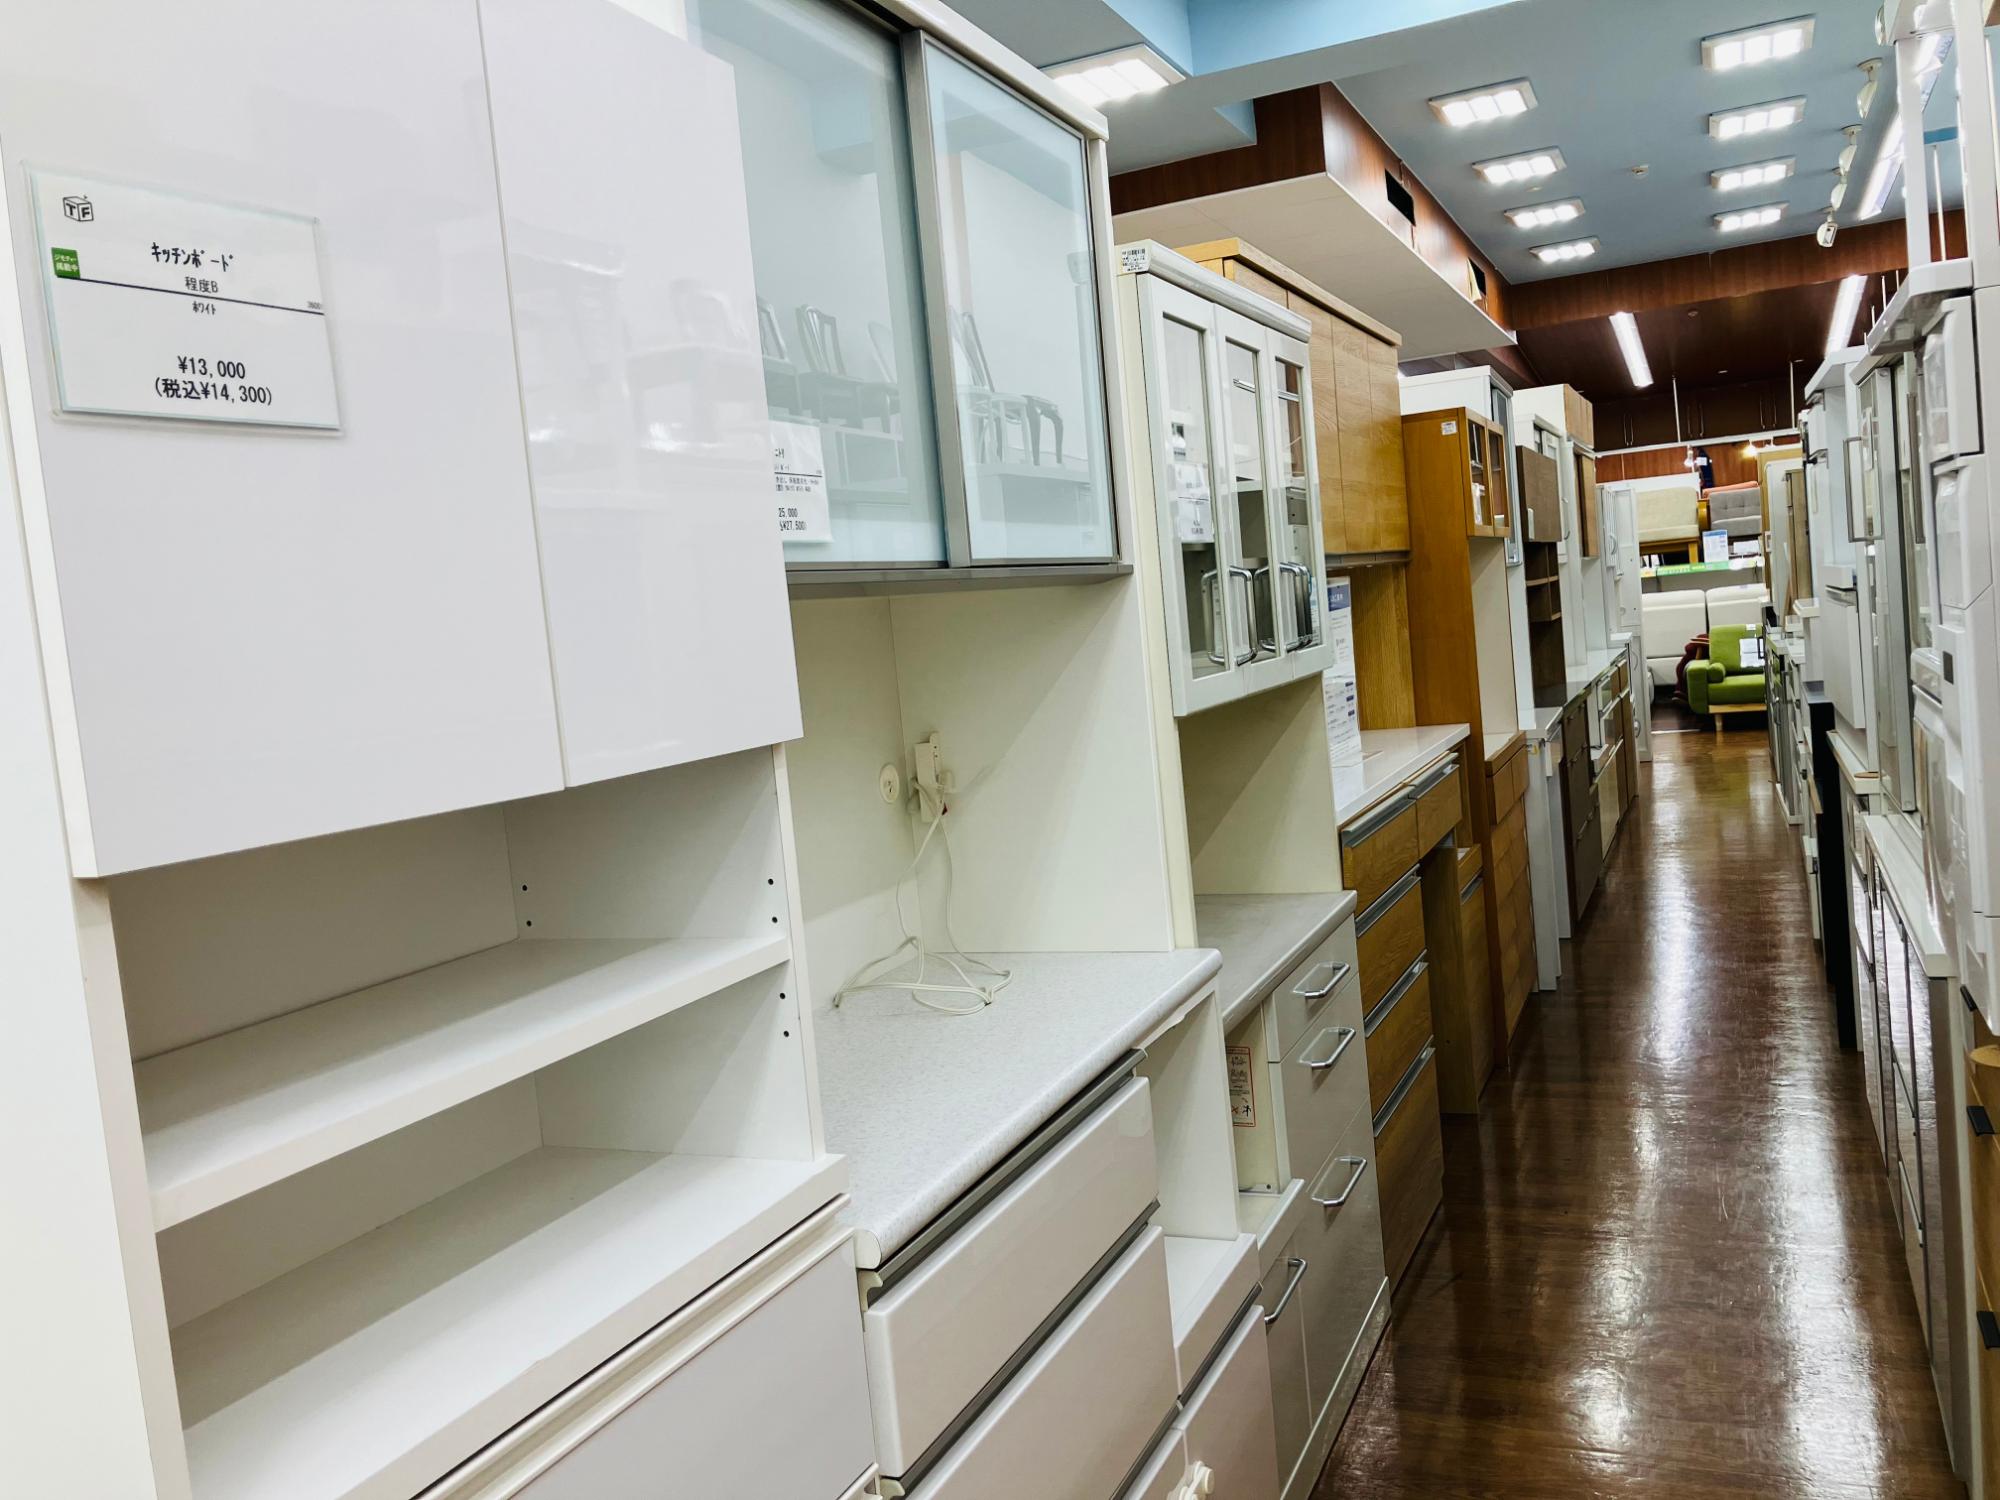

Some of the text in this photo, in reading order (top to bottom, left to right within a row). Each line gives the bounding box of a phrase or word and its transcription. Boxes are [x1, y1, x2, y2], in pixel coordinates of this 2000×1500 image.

[184, 276, 219, 293] 程度B
[192, 301, 217, 316] ホワイト
[177, 355, 246, 380] ¥13,000
[155, 377, 272, 406] (税込¥14,300)
